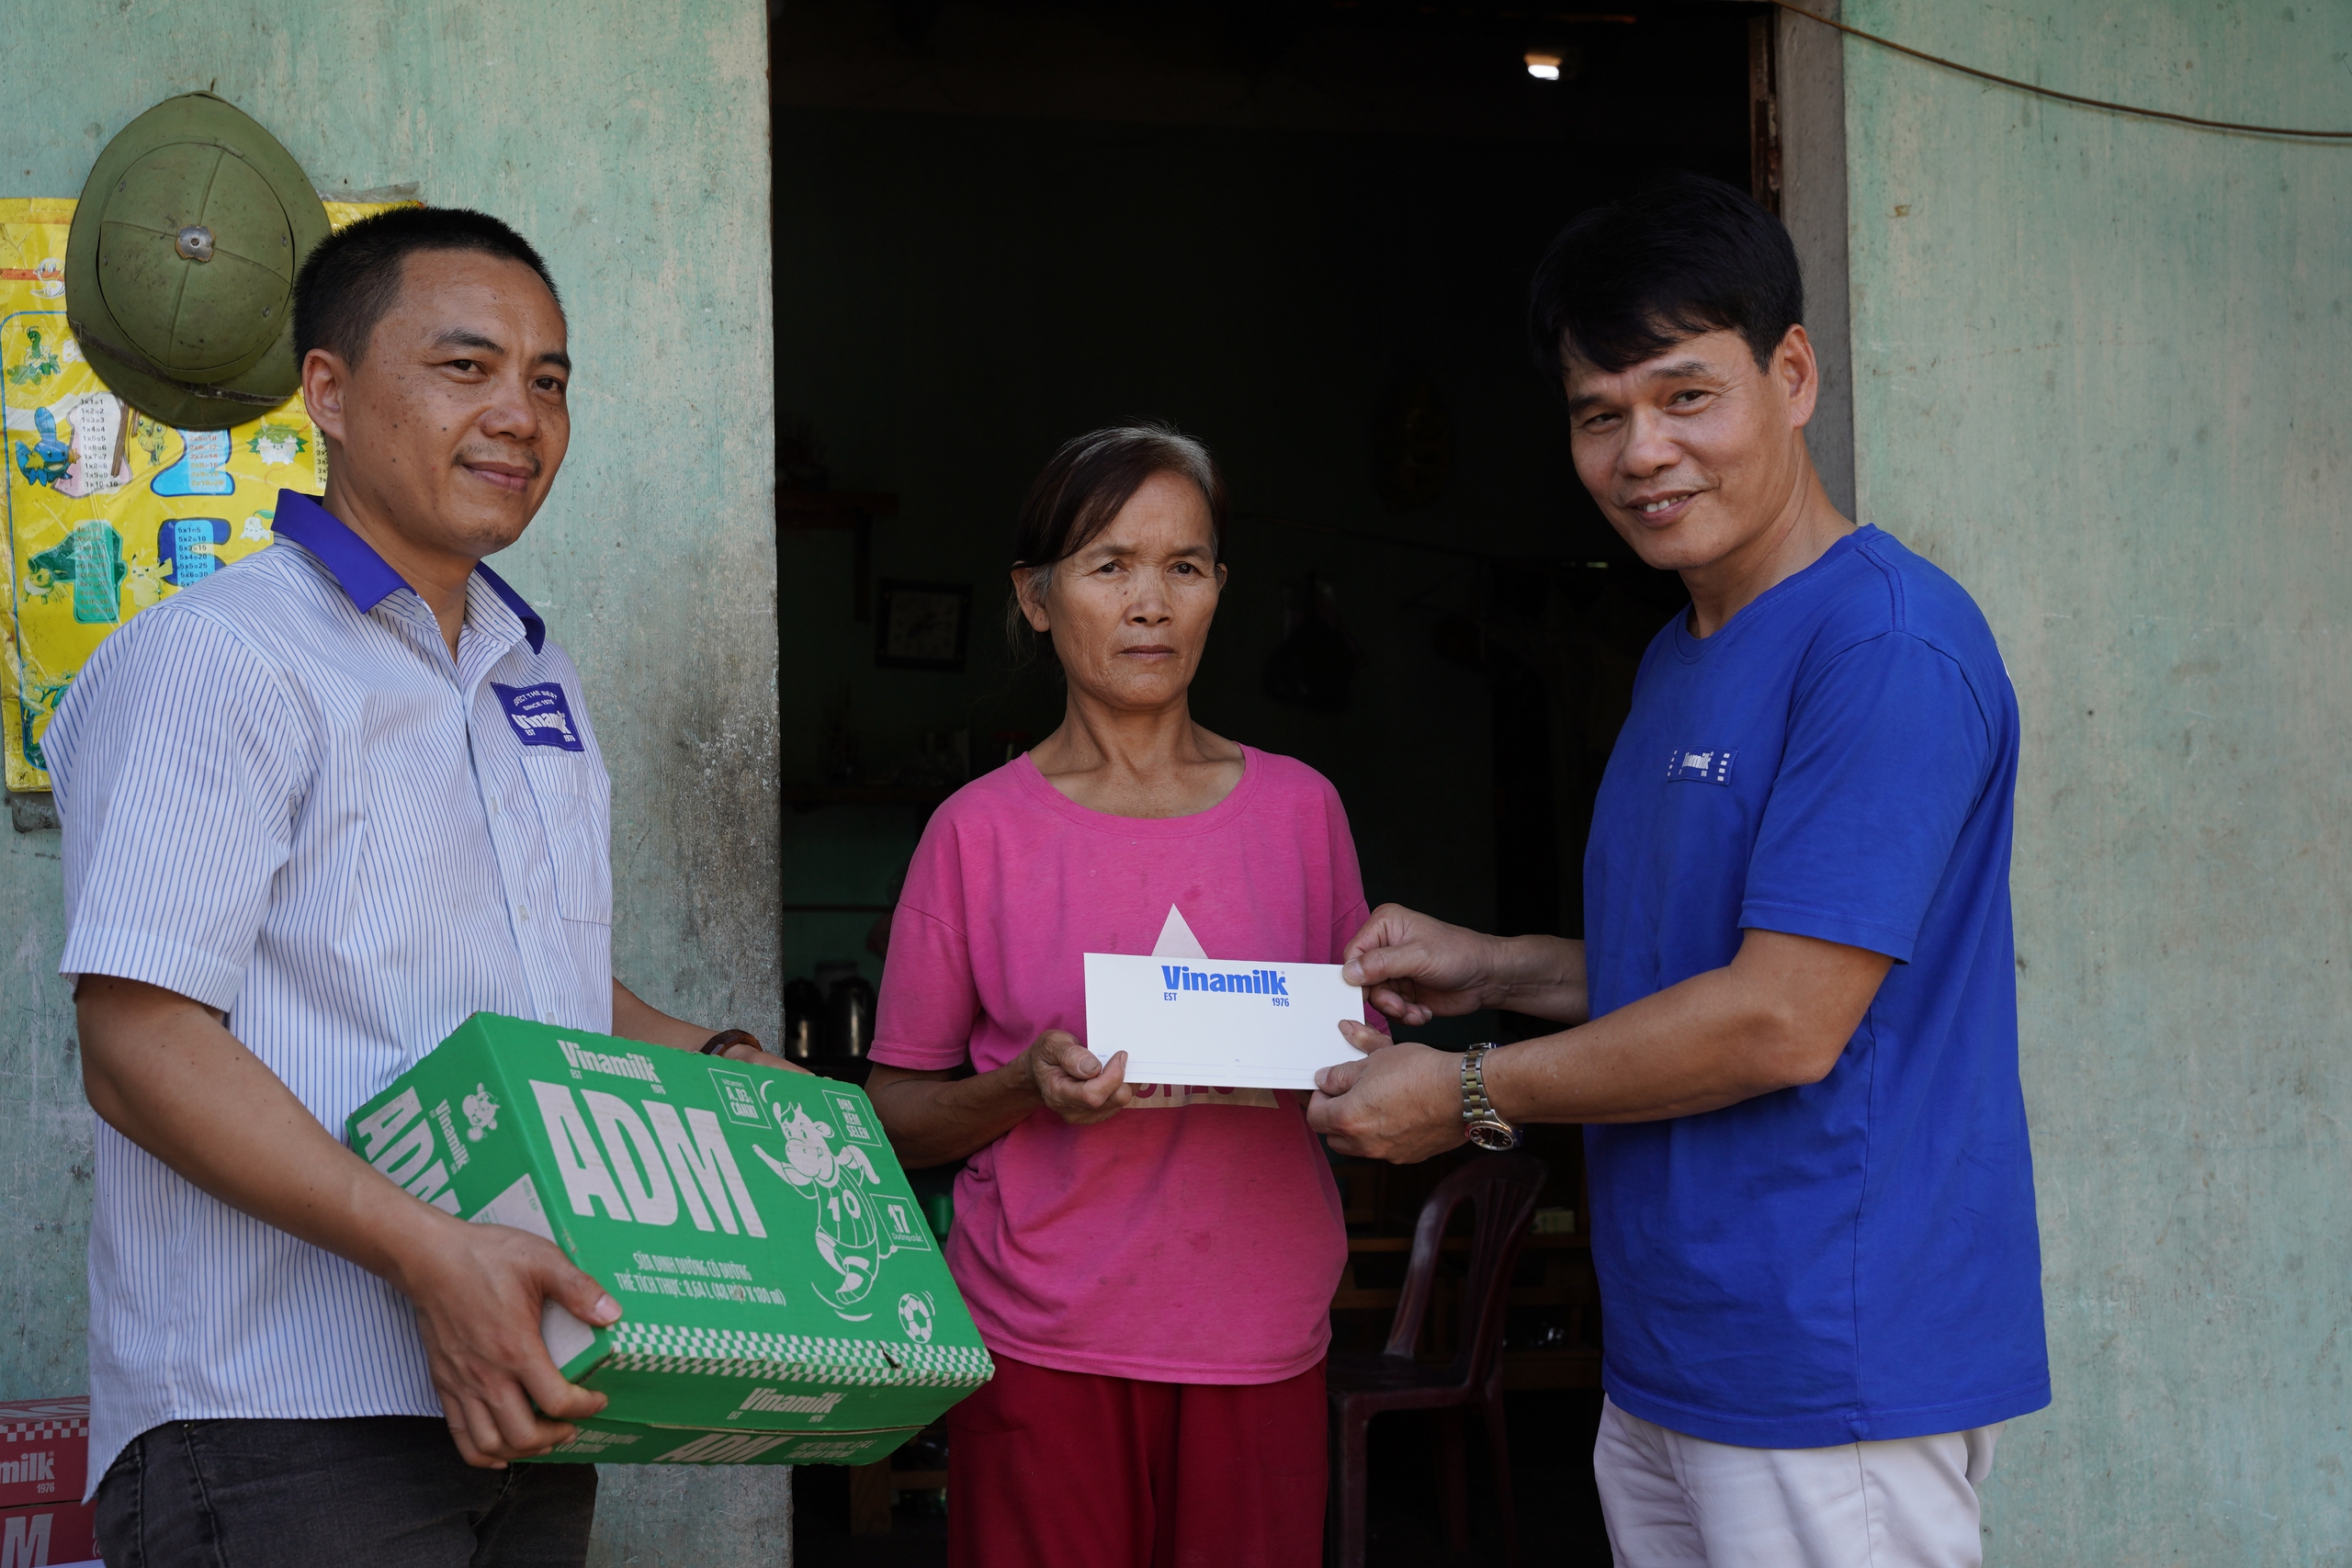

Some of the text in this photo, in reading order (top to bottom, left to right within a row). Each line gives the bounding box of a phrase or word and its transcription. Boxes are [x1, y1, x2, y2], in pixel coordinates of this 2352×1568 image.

[1161, 965, 1289, 995] Vinamilk
[1164, 992, 1177, 1001] EST
[1272, 998, 1290, 1007] 1976
[557, 1039, 662, 1083] Vinamilk
[570, 1068, 582, 1079] EST
[650, 1084, 666, 1094] 1976
[435, 1099, 469, 1171] Vinamilk
[528, 1079, 768, 1239] ADM
[827, 1189, 861, 1223] 10
[739, 1387, 843, 1414] Vinamilk
[652, 1433, 796, 1463] ADM
[37, 1483, 55, 1494] 1976
